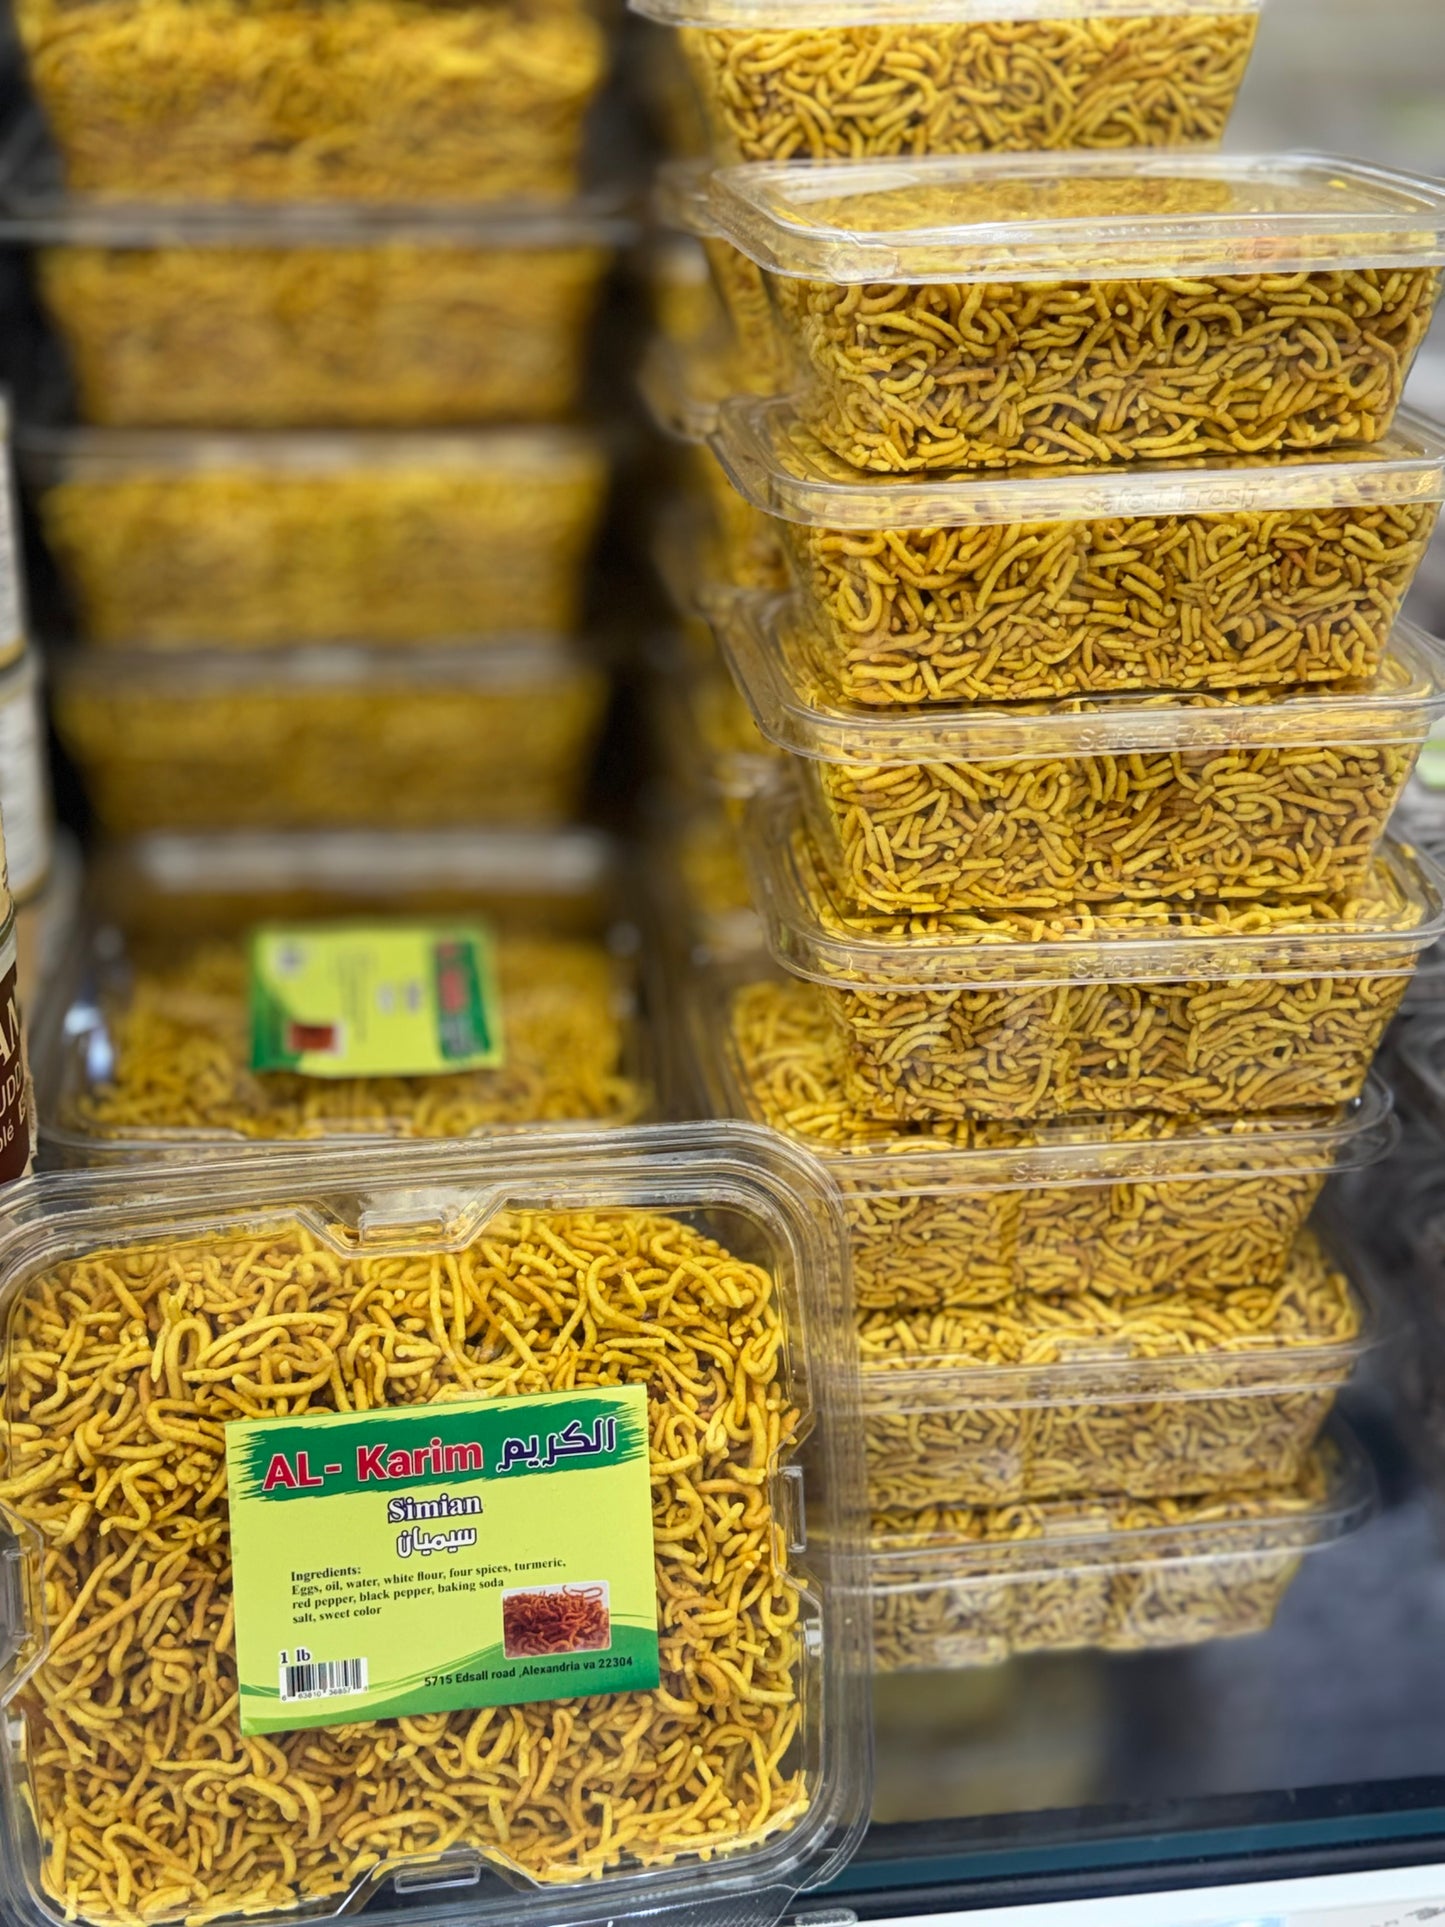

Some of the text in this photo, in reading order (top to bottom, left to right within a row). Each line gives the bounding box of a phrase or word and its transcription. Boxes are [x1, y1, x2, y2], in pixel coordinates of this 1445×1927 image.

[496, 1417, 617, 1473] الكريم
[262, 1437, 484, 1491] AL- Karim
[387, 1493, 483, 1524] Simian
[396, 1526, 477, 1558] سيميان
[291, 1566, 361, 1583] Ingredients:
[292, 1557, 566, 1597] Eggs, oil, water, white flour, four spices, turmeric,
[292, 1577, 504, 1609] red pepper, black pepper, baking soda
[292, 1605, 382, 1624] salt, sweet color
[281, 1649, 311, 1664] 1 lb
[424, 1675, 452, 1687] 5715
[456, 1670, 488, 1683] Edsall
[491, 1667, 516, 1679] road
[583, 1661, 595, 1670] va
[598, 1656, 633, 1669] 22304
